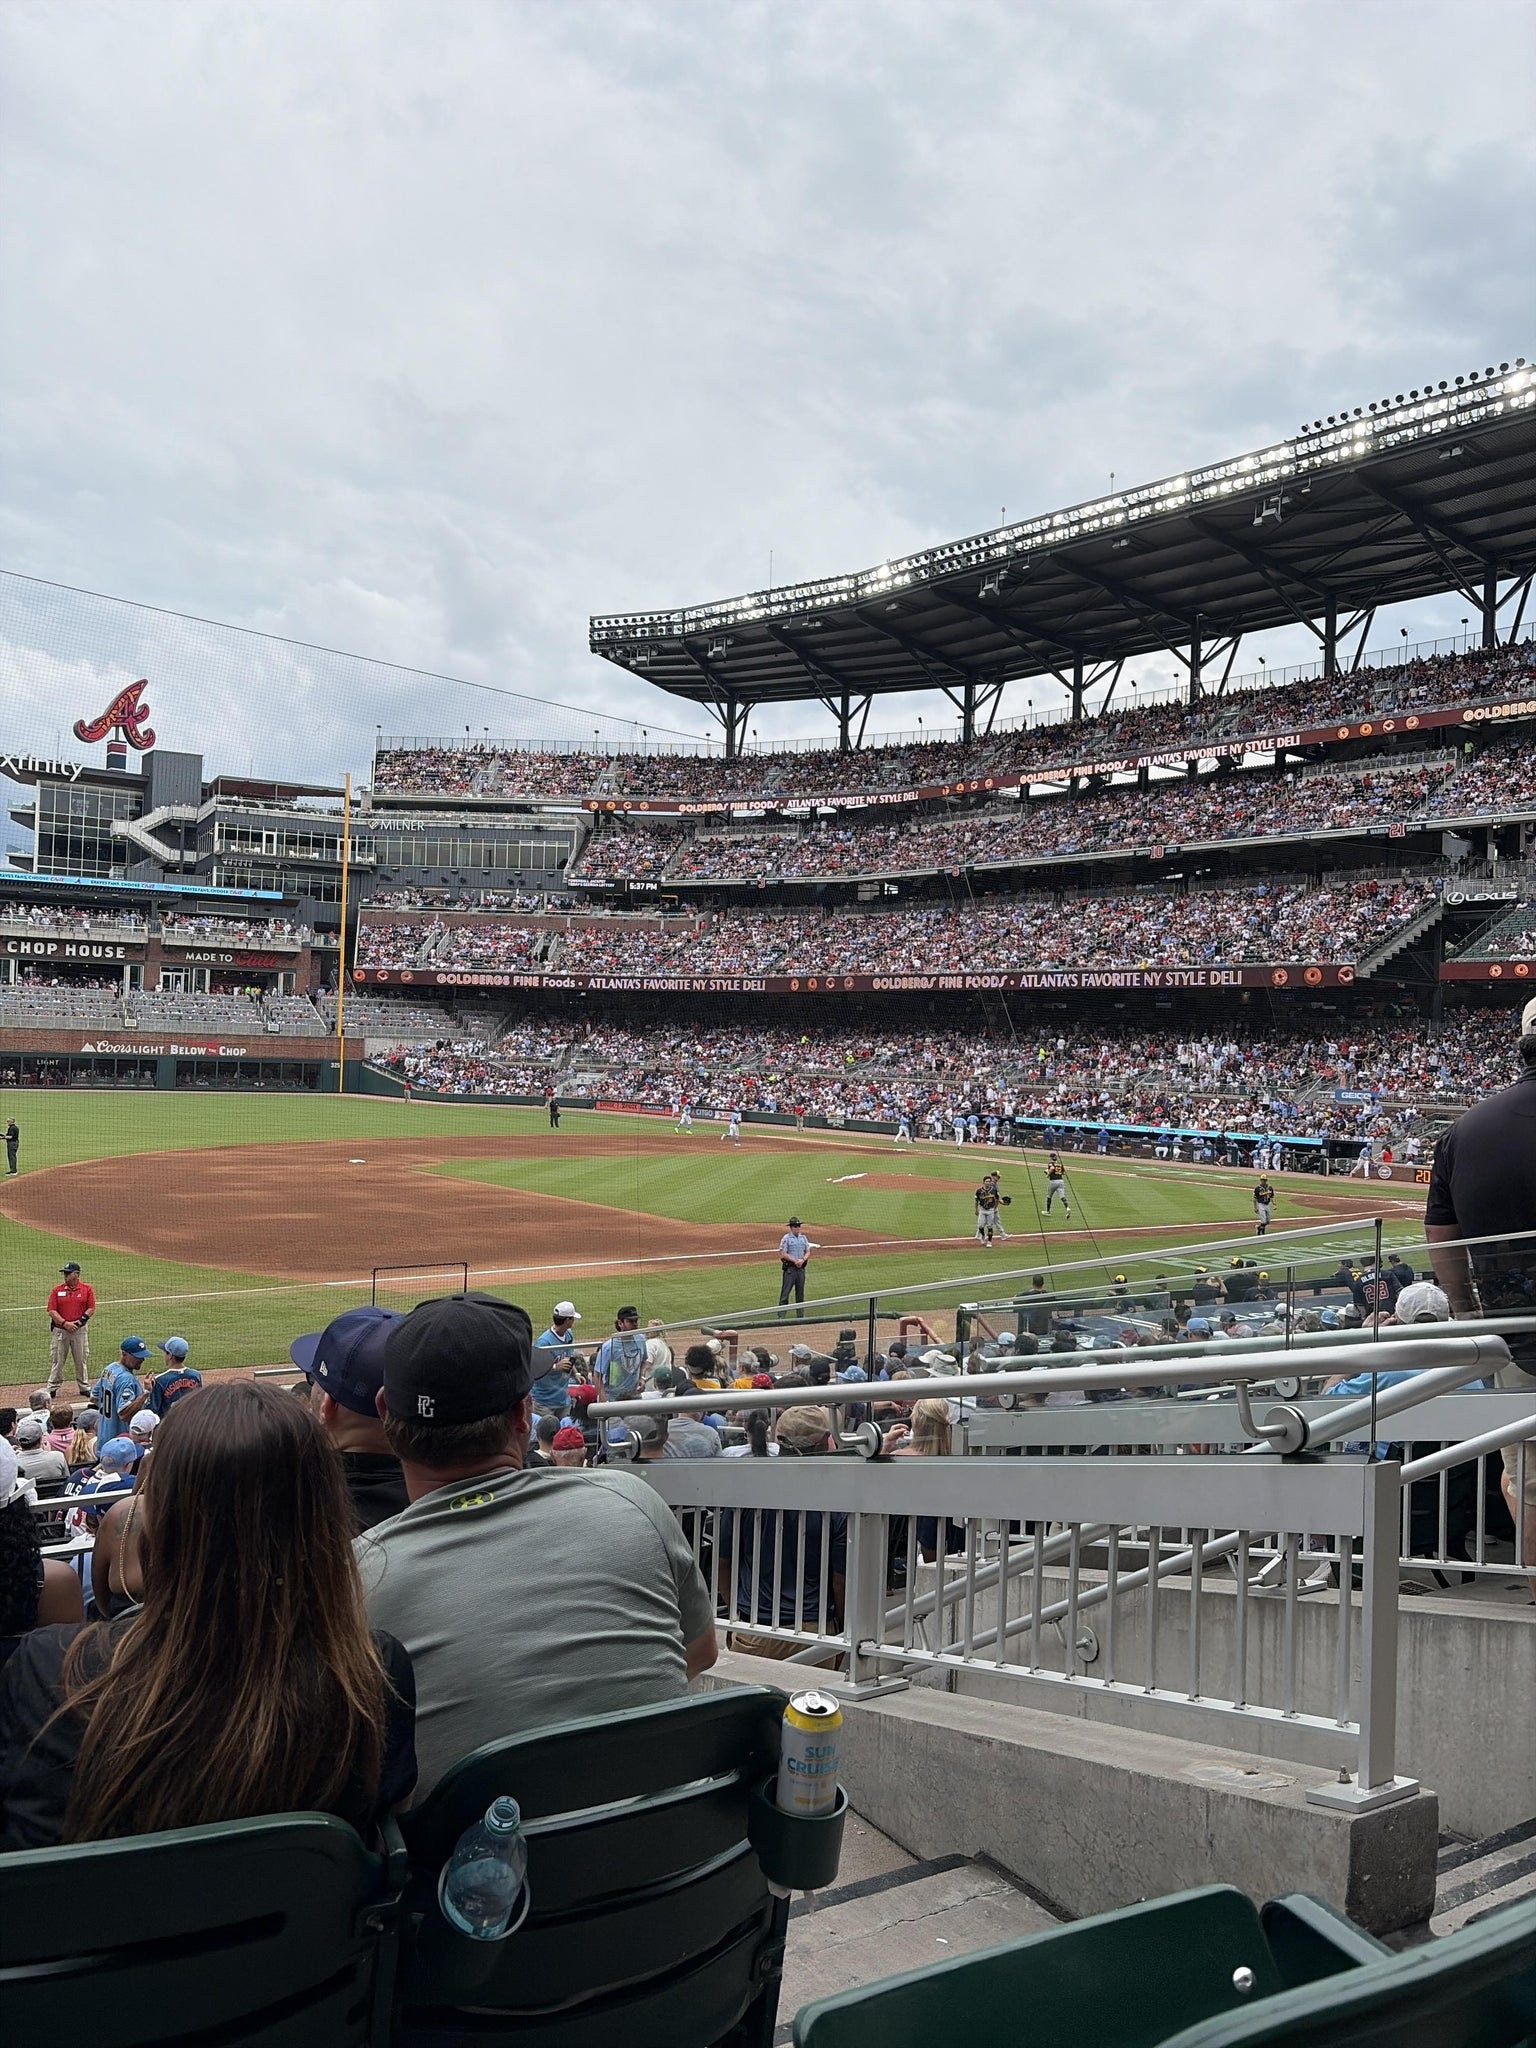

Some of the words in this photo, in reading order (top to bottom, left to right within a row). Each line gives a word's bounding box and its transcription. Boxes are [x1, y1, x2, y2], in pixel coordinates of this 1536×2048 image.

[1020, 768, 1072, 784] GOLDBERGS
[1073, 765, 1093, 777] FINE
[1094, 760, 1127, 773] FOODS
[1137, 752, 1181, 768] ATLANTA'S
[1183, 746, 1228, 761] FAVORITE
[1229, 743, 1243, 755] NY
[1245, 738, 1275, 752] STYLE
[1276, 734, 1300, 749] DELI
[679, 803, 728, 812] GOLDBERGS
[730, 801, 748, 811] FINE
[749, 800, 779, 810] FOODS
[787, 799, 826, 808] ATLANTA'S
[827, 796, 864, 806] FAVORITE
[866, 795, 878, 804] NY
[879, 793, 902, 804] STYLE
[903, 791, 919, 801] DELI
[380, 819, 425, 831] MILNER
[1389, 822, 1405, 838] 21
[1150, 845, 1164, 859] 10
[629, 882, 644, 890] 5:37
[645, 882, 658, 890] PM
[1466, 892, 1517, 901] LEXUS
[7, 941, 58, 955] CHOP
[65, 943, 125, 958] HOUSE
[185, 952, 216, 961] MADE
[219, 953, 233, 962] TO
[436, 973, 510, 986] GOLDBERGS
[513, 975, 540, 987] FINE
[543, 977, 575, 988] Foods
[588, 978, 641, 990] ATLANTA'S
[643, 978, 690, 990] FAVORITE
[692, 979, 706, 990] NY
[709, 979, 740, 991] STYLE
[743, 979, 766, 991] DELI
[872, 976, 936, 990] GOLDBERGS
[938, 975, 963, 989] FINE
[965, 975, 1008, 989] FOODS
[1019, 974, 1078, 987] ATLANTA'S
[1081, 972, 1141, 987] FAVORITE
[1143, 971, 1163, 986] NY
[1165, 971, 1206, 986] STYLE
[1210, 970, 1242, 985] DELI
[96, 1040, 132, 1054] Coors
[133, 1045, 165, 1055] LIGHT
[170, 1044, 206, 1055] BELOW
[219, 1046, 247, 1056] CHOP
[1415, 1170, 1431, 1183] 20
